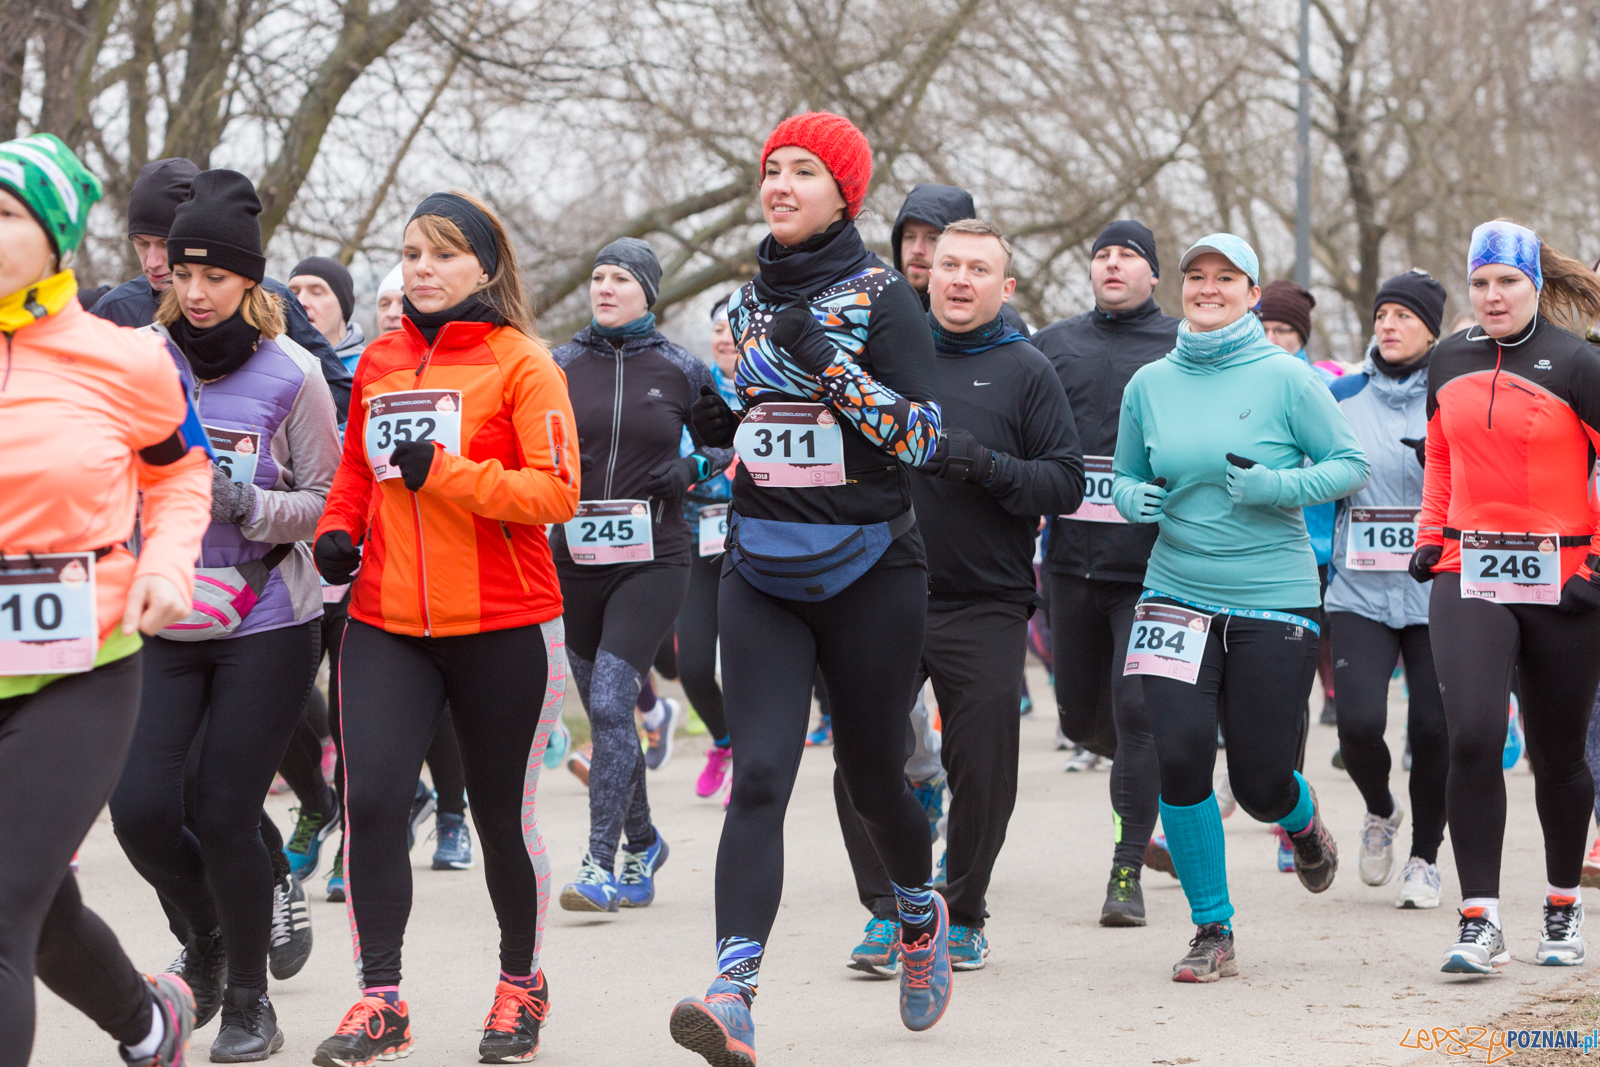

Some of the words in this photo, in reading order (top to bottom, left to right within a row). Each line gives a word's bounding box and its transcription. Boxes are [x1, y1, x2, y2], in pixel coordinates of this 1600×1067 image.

[377, 417, 436, 449] 352
[753, 428, 815, 458] 311
[580, 519, 634, 543] 245
[1363, 526, 1415, 548] 168
[1479, 554, 1541, 579] 246
[1, 592, 63, 631] 10
[1134, 625, 1185, 654] 284
